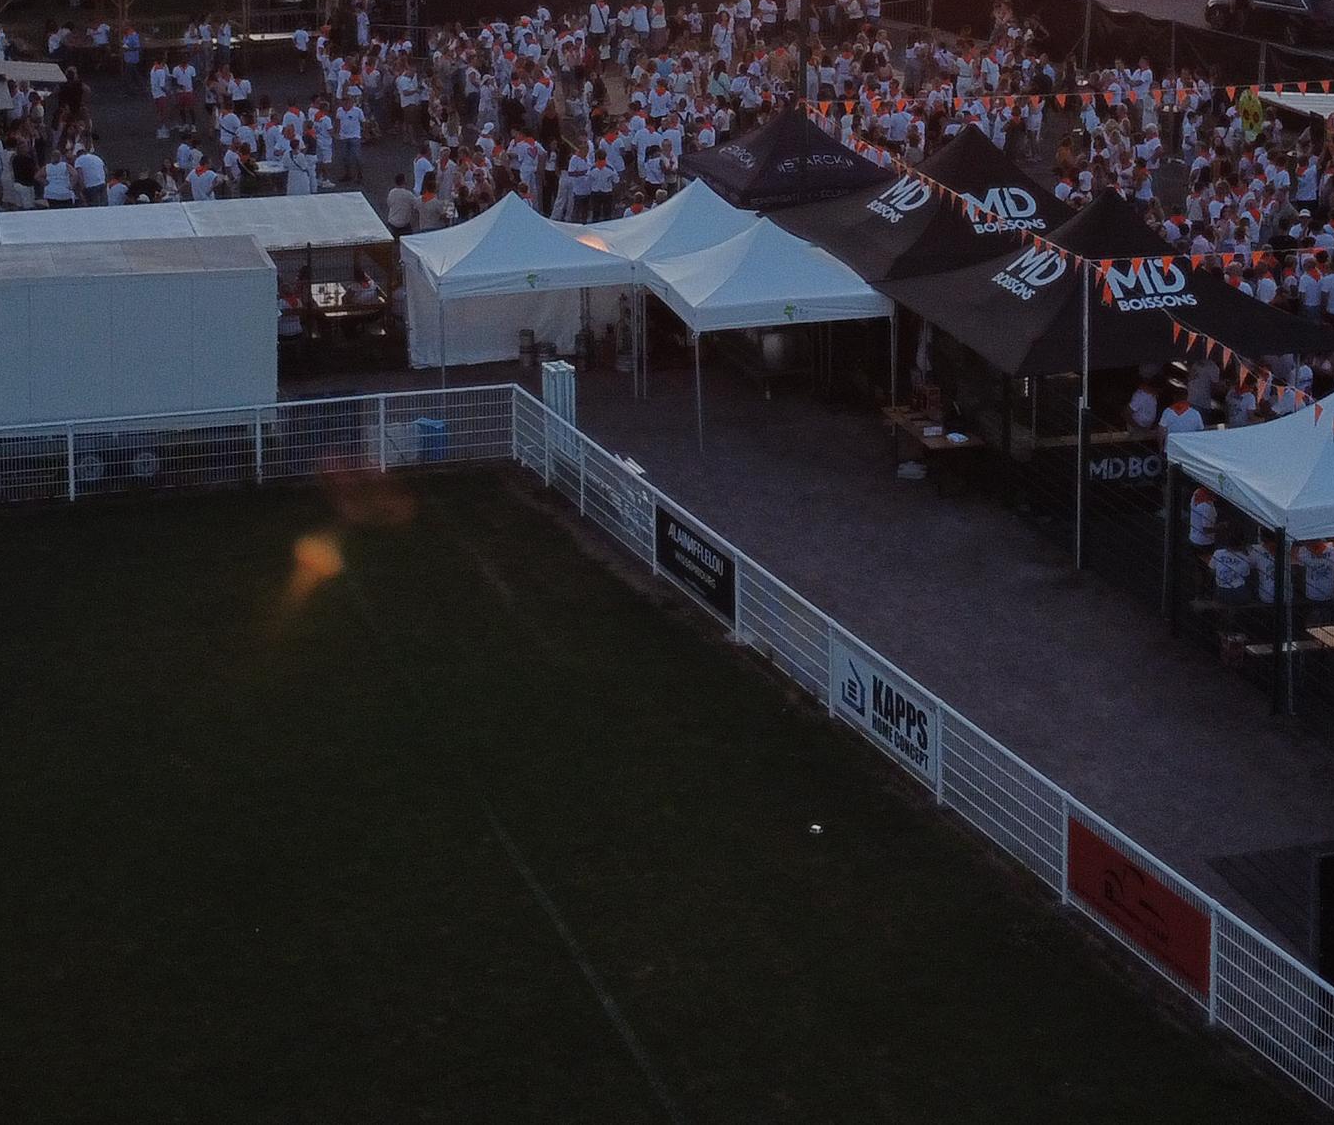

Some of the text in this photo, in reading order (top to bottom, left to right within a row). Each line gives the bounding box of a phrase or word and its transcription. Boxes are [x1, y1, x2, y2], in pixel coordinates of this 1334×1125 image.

[878, 174, 931, 211] MD
[959, 187, 1037, 221] MD
[972, 218, 1047, 235] BOISSONS
[1005, 245, 1068, 287] MD
[1105, 257, 1186, 299] MD
[990, 272, 1036, 301] BOISSONS
[1116, 293, 1198, 312] BOISSONS
[872, 674, 928, 750] KAPPS
[872, 712, 928, 771] HOME CONCEPT
